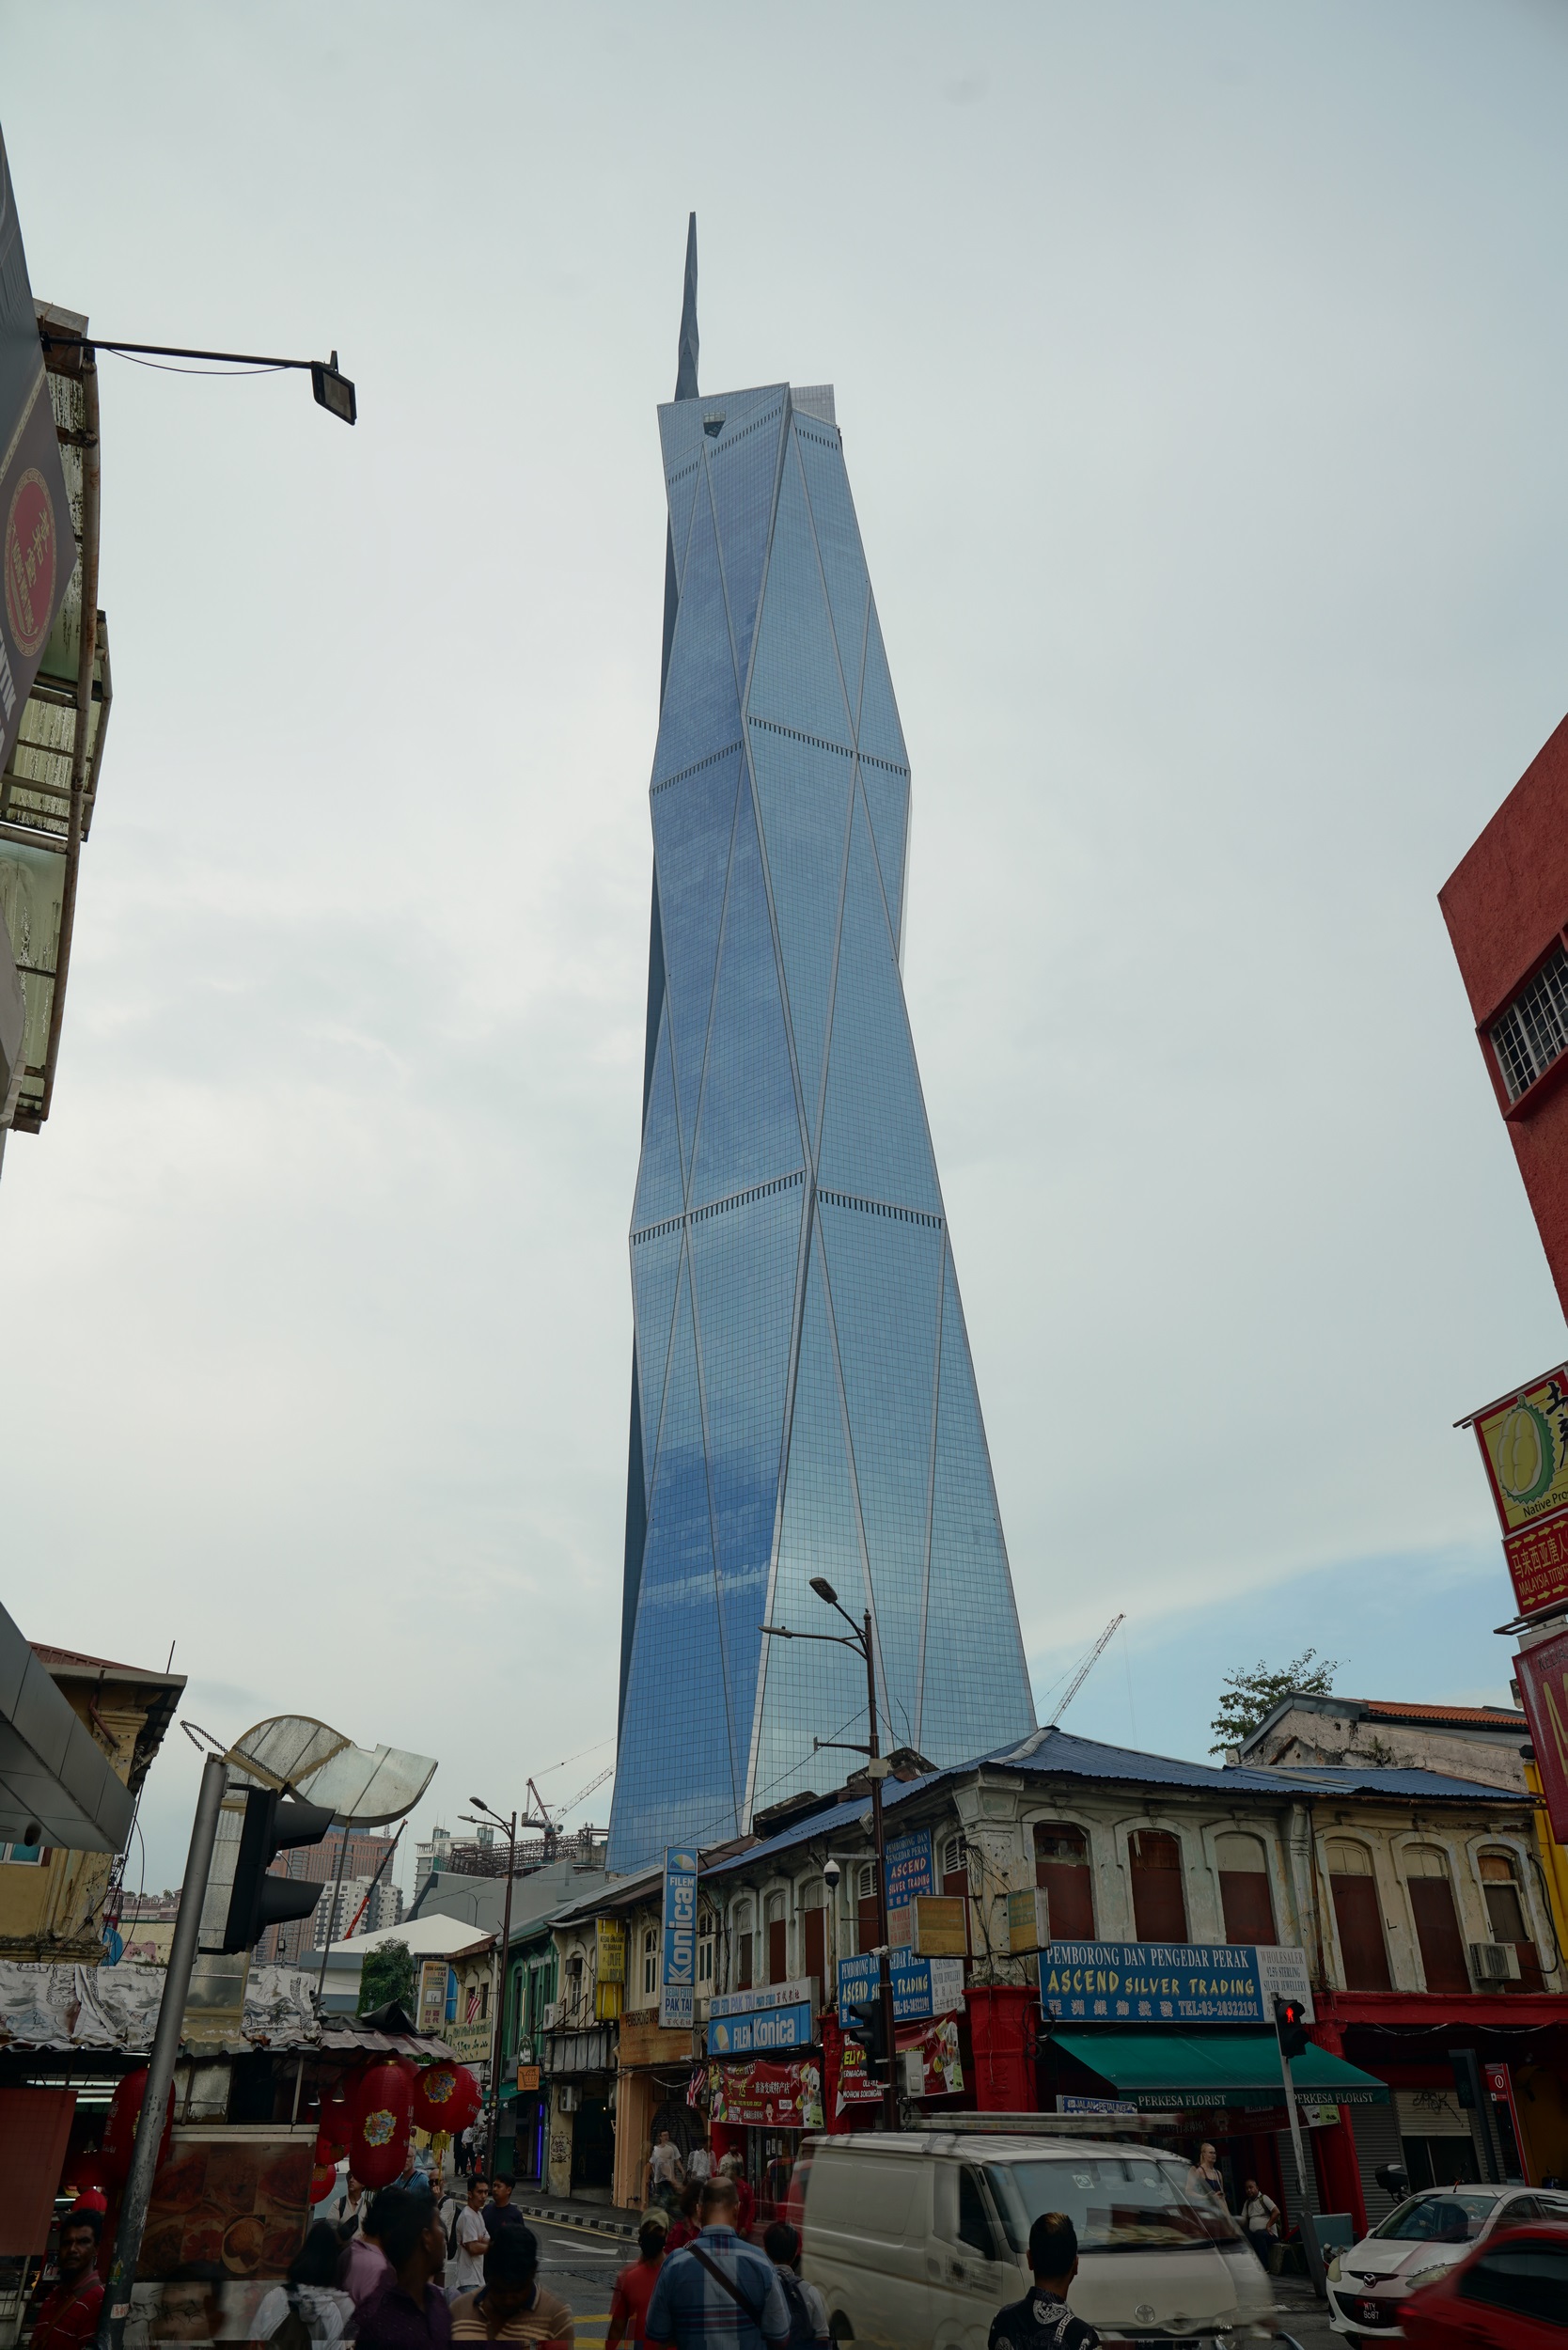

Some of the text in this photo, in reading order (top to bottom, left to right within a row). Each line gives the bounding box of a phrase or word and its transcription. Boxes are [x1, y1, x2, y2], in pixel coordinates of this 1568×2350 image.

[1523, 1499, 1551, 1518] Native
[1518, 1572, 1549, 1597] MALAYSIA
[886, 1832, 929, 1854] PEMBORONG DAN
[912, 1842, 929, 1856] PERAK
[890, 1857, 927, 1879] ASCEND
[669, 1876, 694, 1888] FILEM
[888, 1873, 931, 1895] SILVER TRADING
[668, 1887, 694, 1985] Konica
[1045, 1945, 1249, 1968] PEMBORONG DAN PENGEDAR PERAK
[1260, 1950, 1305, 1965] WHOLESALER
[841, 1961, 869, 1980] PEMBORONG
[1278, 1966, 1301, 1978] STERLING
[842, 1981, 869, 2005] ASCEND
[897, 1974, 928, 1997] TRADING
[1047, 1968, 1255, 1997] ASCEND SILVER TRADING
[1263, 1980, 1307, 1992] SILVER JEWELLERY
[665, 1987, 693, 1998] KEDAI FOTO
[665, 1998, 693, 2012] PAK TAI
[730, 1997, 743, 2013] PAK
[744, 1994, 756, 2011] TAI
[1178, 1999, 1259, 2017] TEL:03-20322191
[733, 2013, 795, 2049] FILEM Konica
[843, 2090, 859, 2098] MOHON
[1137, 2094, 1227, 2107] PERKESA FLORIST
[1294, 2092, 1373, 2104] PERKESA FLORIST
[1076, 2099, 1095, 2110] JALAN
[1098, 2102, 1126, 2112] PETALING
[1363, 2301, 1376, 2311] WTY
